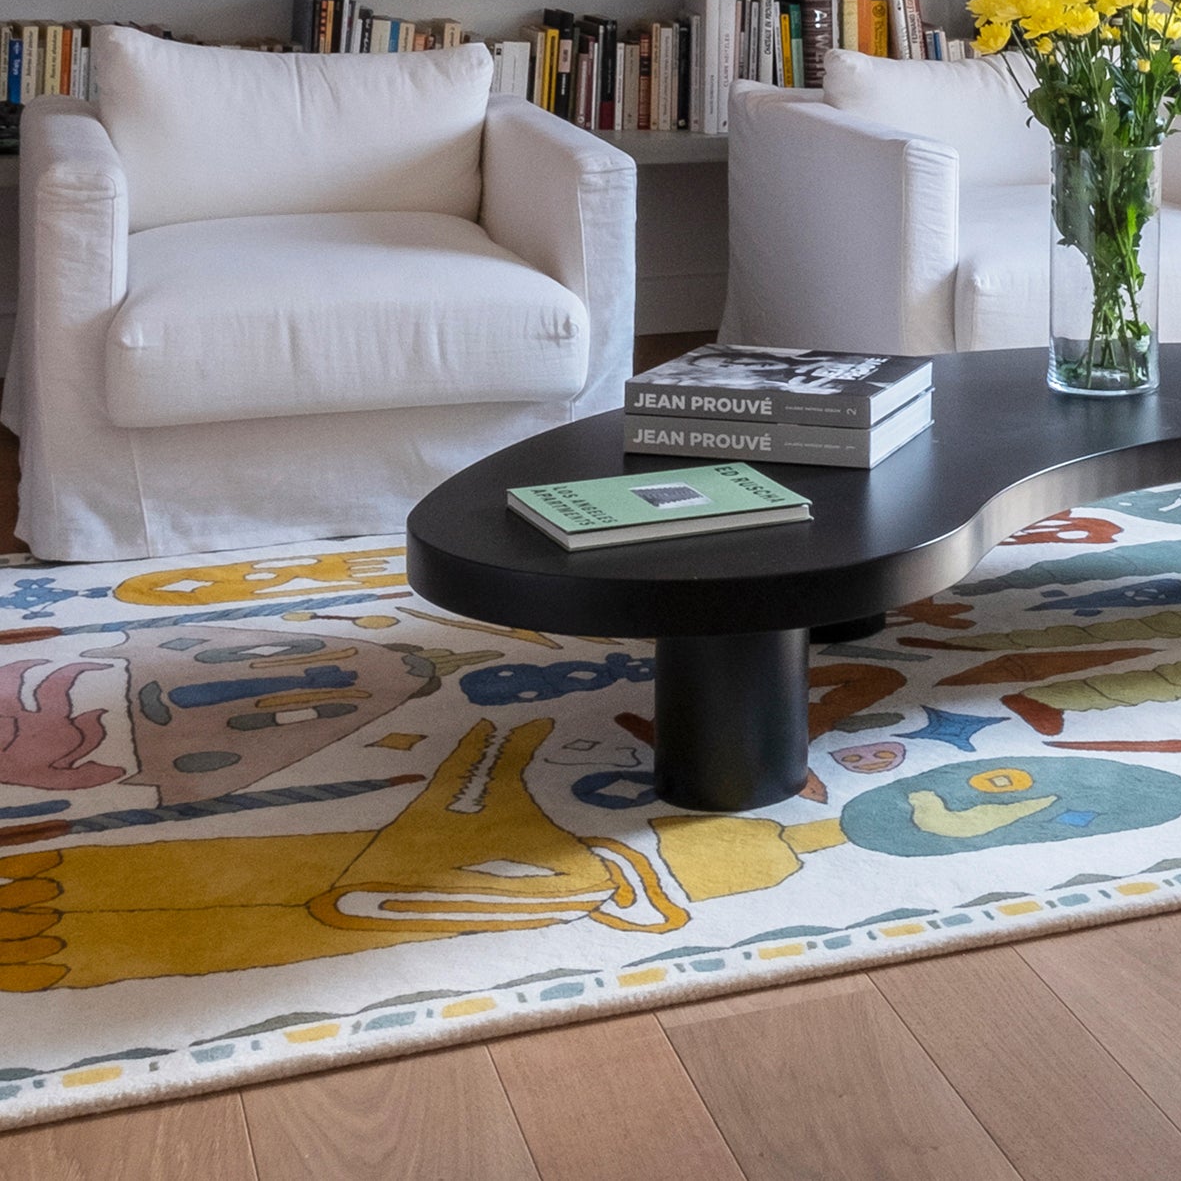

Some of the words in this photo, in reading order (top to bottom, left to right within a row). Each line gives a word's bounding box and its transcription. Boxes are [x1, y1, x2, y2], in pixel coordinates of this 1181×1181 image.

[634, 392, 686, 410] JEAN
[690, 396, 773, 416] PROUVÉ
[847, 407, 857, 416] 2
[633, 429, 685, 446] JEAN
[690, 432, 772, 452] PROUVÉ
[714, 466, 739, 477] ED
[729, 476, 786, 504] RUSCHA
[530, 488, 596, 526] APARTMENTS
[553, 485, 578, 500] LOS
[572, 498, 618, 524] ANGELES
